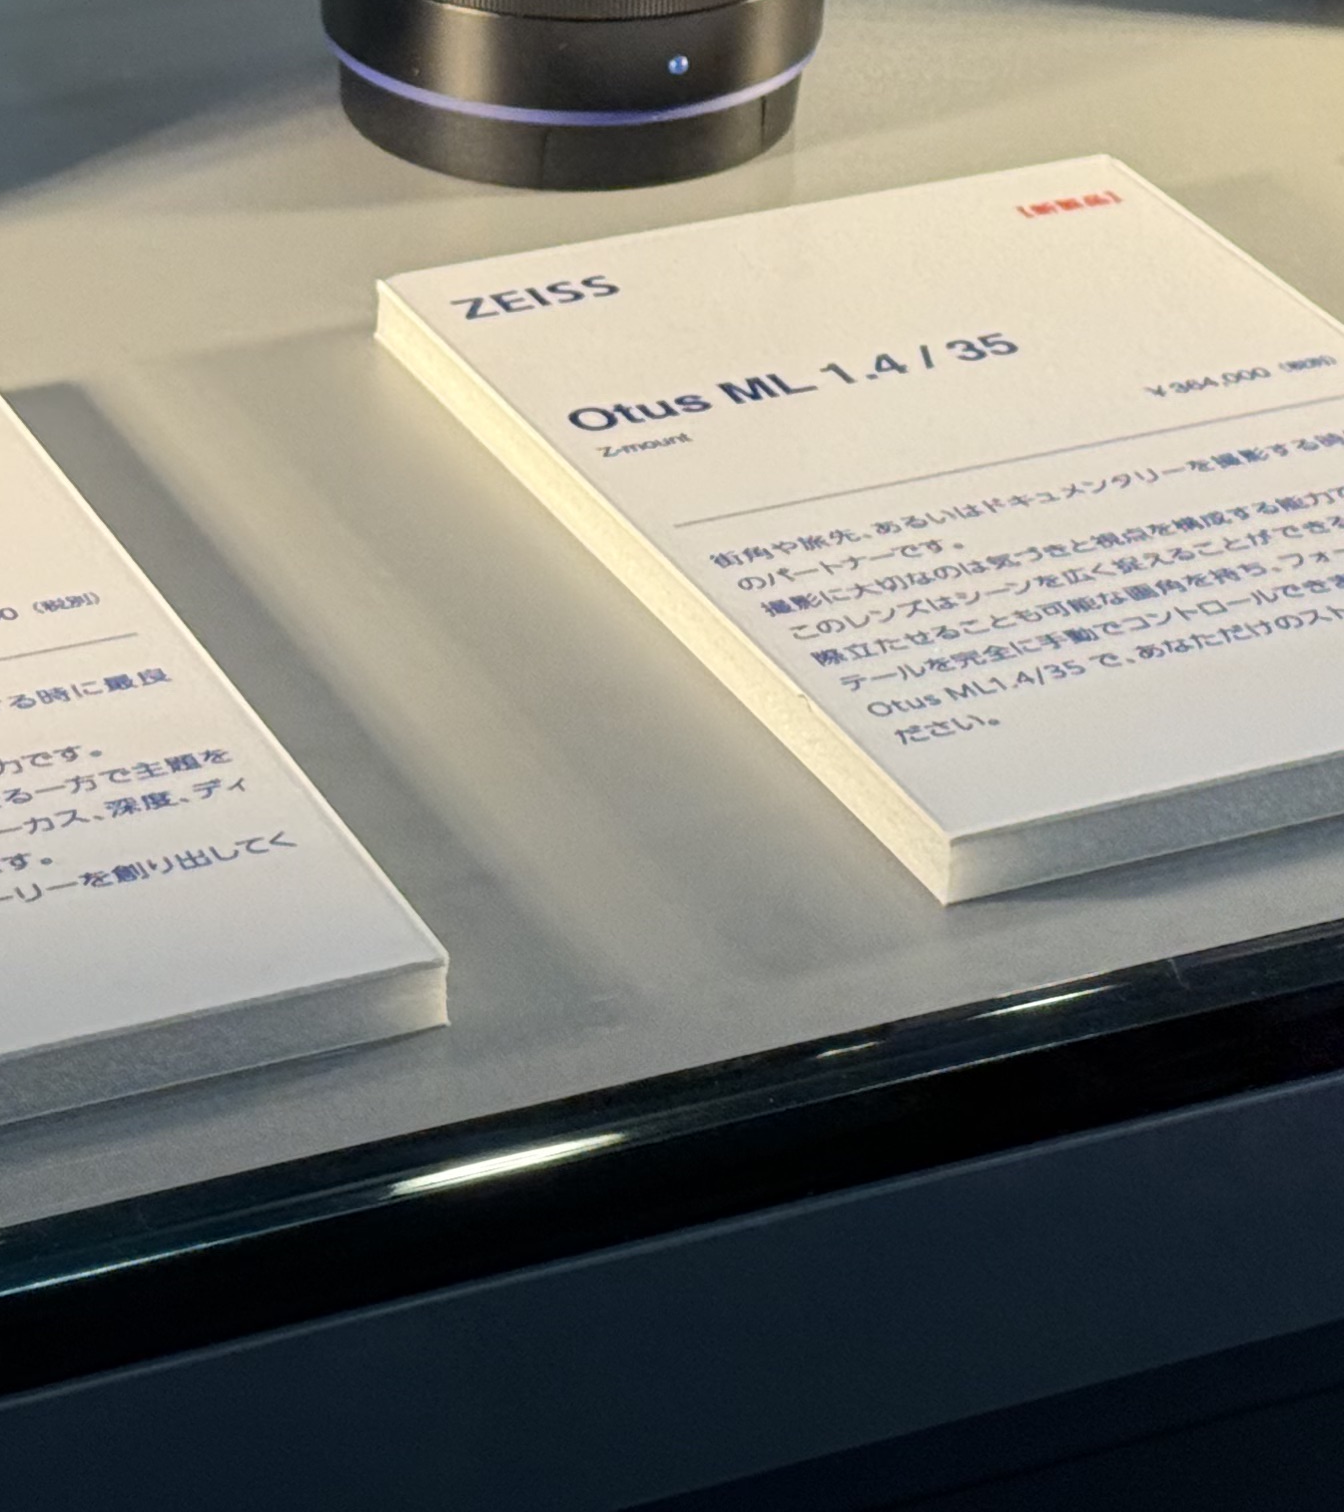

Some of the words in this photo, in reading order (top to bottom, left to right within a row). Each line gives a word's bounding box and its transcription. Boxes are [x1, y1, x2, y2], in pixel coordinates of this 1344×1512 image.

[449, 274, 621, 321] ZEISS
[567, 393, 714, 432] Otus
[716, 372, 818, 406] ML
[819, 352, 909, 386] 1.4
[945, 331, 1020, 362] 35
[595, 432, 694, 458] Z-mount
[865, 692, 943, 718] Otus
[893, 713, 1001, 746] ださい。
